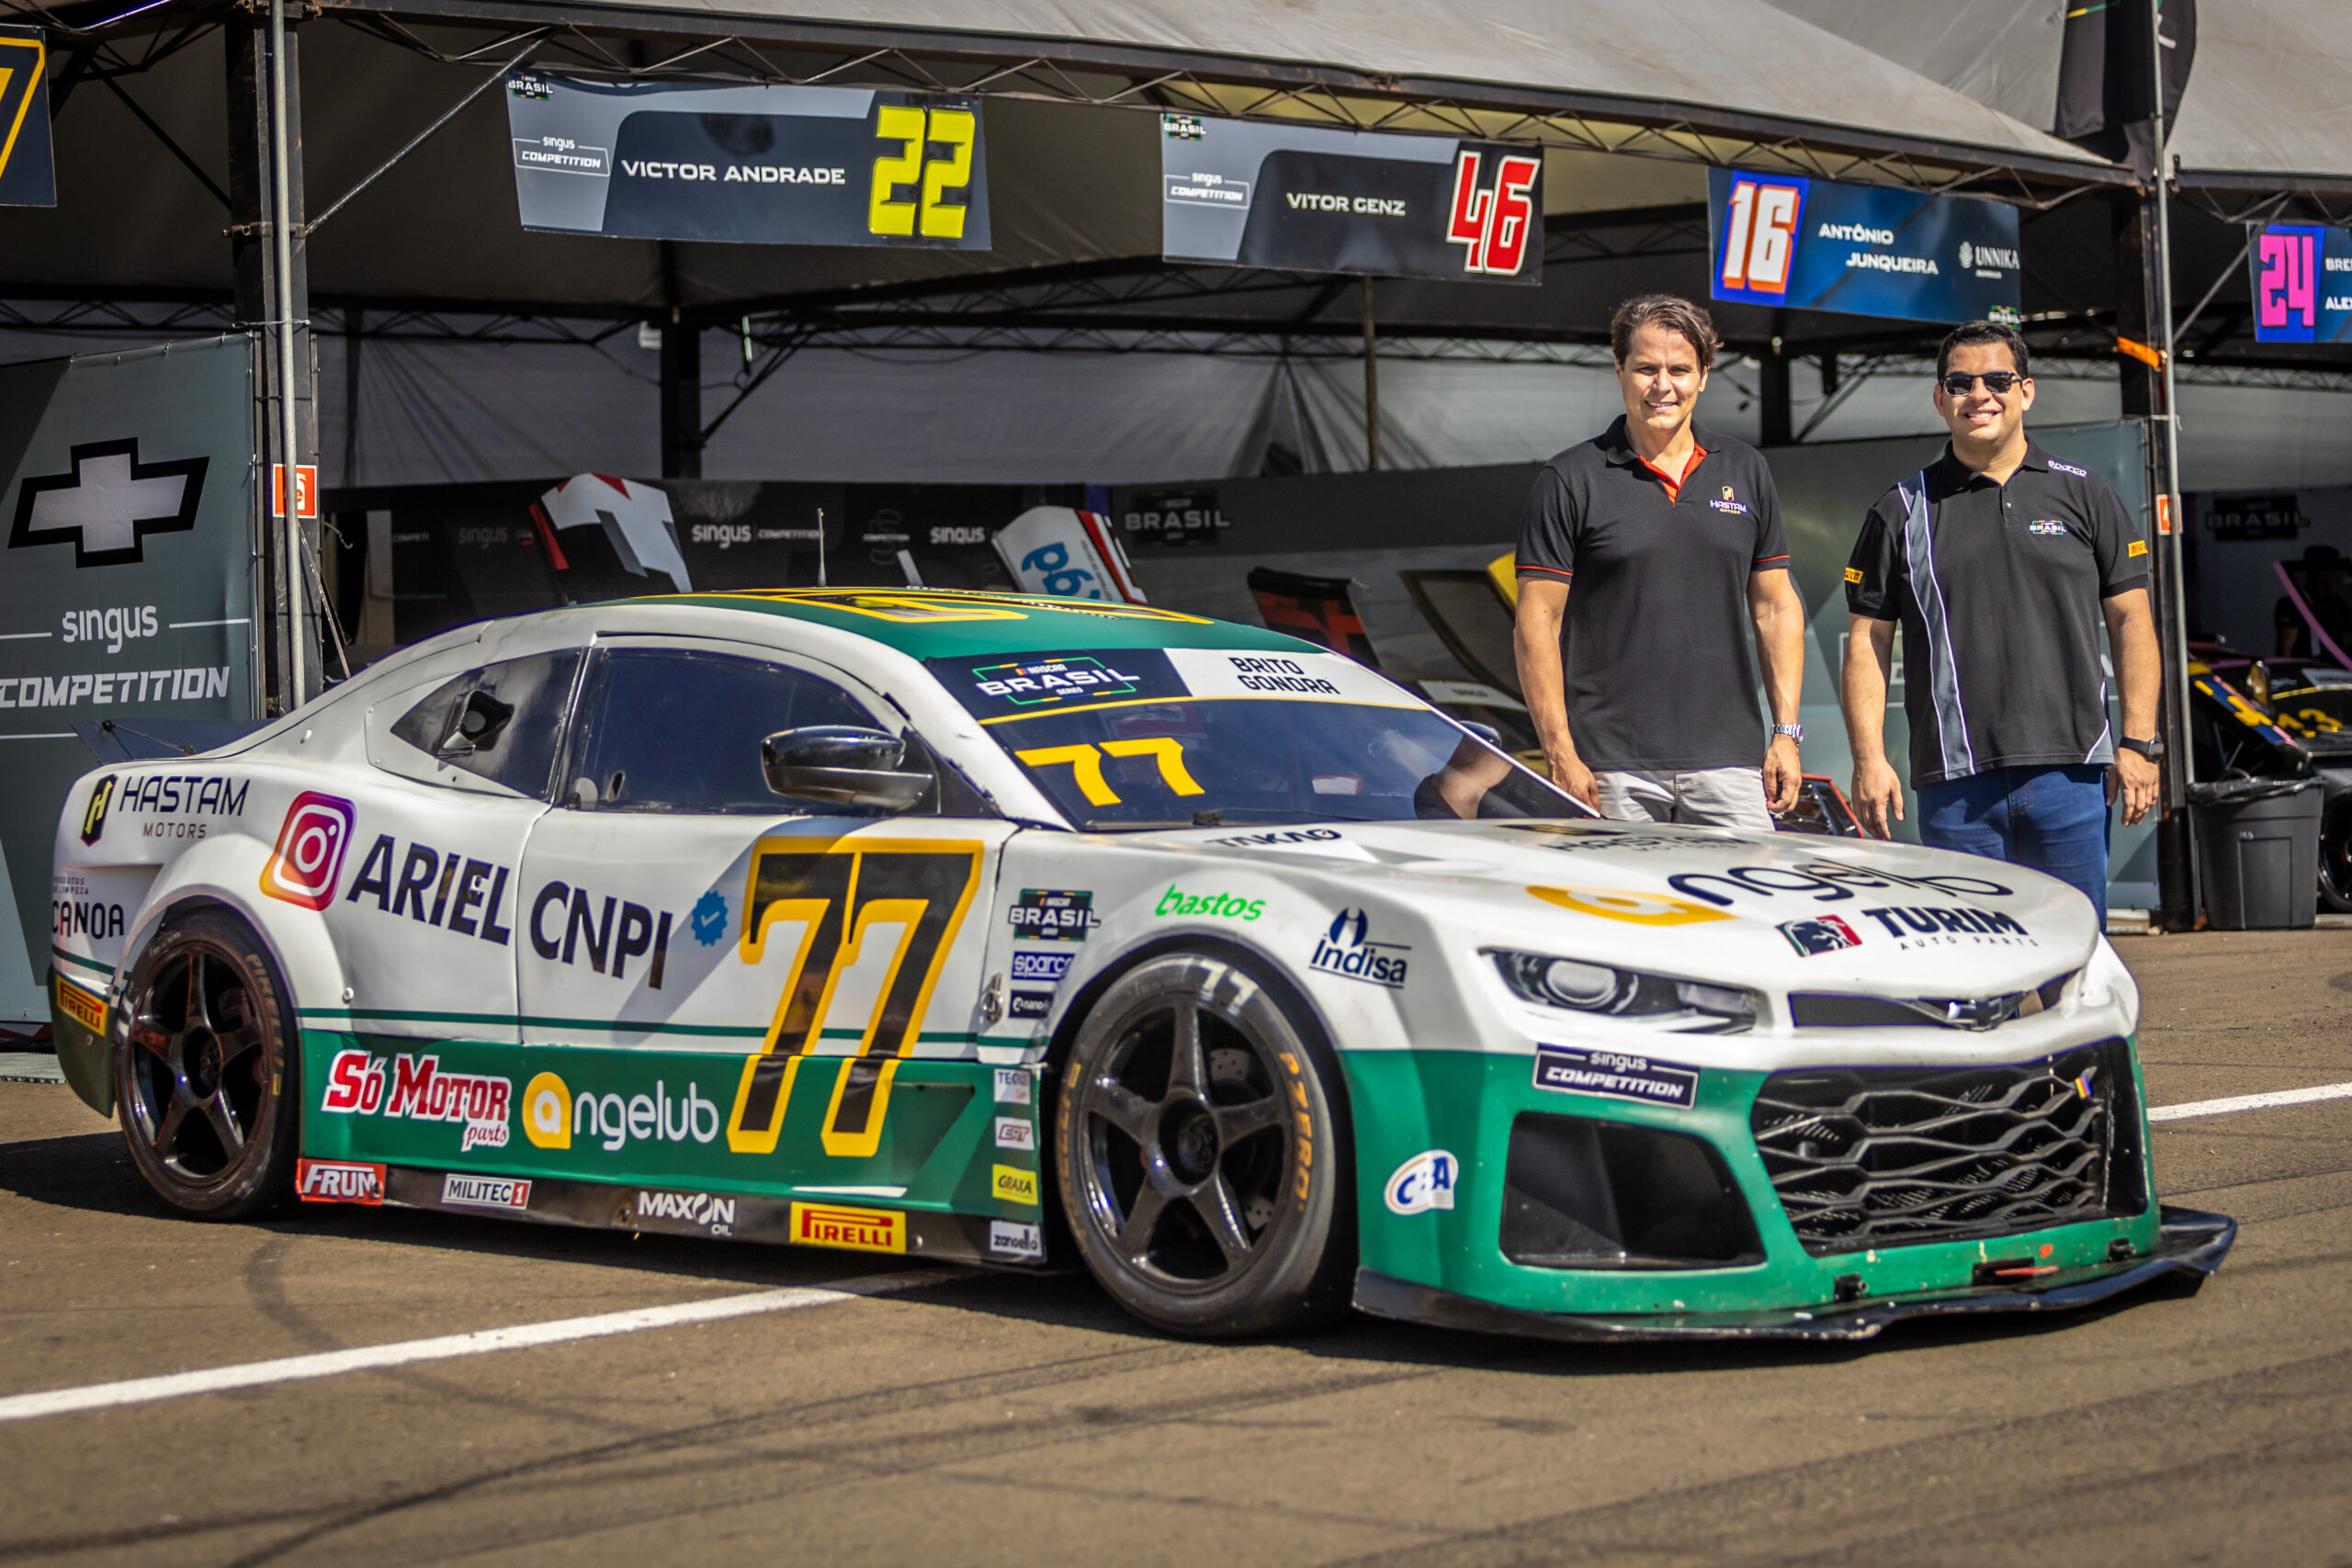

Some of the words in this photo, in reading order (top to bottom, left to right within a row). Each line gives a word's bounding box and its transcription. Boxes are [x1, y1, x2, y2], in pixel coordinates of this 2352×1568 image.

[508, 80, 553, 94] BRASIL
[1163, 122, 1207, 135] BRASIL
[542, 136, 575, 152] singus
[522, 151, 601, 168] COMPETITION
[620, 159, 717, 182] VICTOR
[724, 165, 845, 185] ANDRADE
[868, 105, 976, 238] 22
[1170, 186, 1243, 201] COMPETITION
[1286, 192, 1349, 212] VITOR
[1353, 197, 1406, 217] GENZ
[1446, 150, 1541, 276] 46
[1723, 181, 1798, 294] 16
[1818, 223, 1894, 245] ANTÔNIO
[1845, 252, 1939, 276] JUNQUEIRA
[1974, 245, 2020, 270] UNNIKA
[2259, 233, 2315, 327] 24
[2047, 460, 2086, 477] sparco
[1710, 500, 1747, 513] HASTAM
[1125, 510, 1231, 531] BRASIL
[2029, 524, 2066, 534] BRASIL
[458, 526, 507, 549] singus
[692, 522, 751, 549] singus
[62, 605, 158, 653] singus
[1027, 663, 1068, 675] NASCAR
[1228, 657, 1305, 675] BRITO
[0, 666, 230, 708] COMPETITION
[975, 668, 1141, 696] BRASIL
[1237, 674, 1341, 694] GONDRA
[1014, 737, 1205, 807] 77
[119, 775, 251, 817] HASTAM
[142, 822, 208, 839] MOTORS
[346, 833, 511, 946] ARIEL
[530, 880, 673, 990] CNPI
[1155, 884, 1267, 920] bastos
[51, 900, 125, 940] CANOA
[1009, 906, 1102, 929] BRASIL
[1861, 907, 2030, 938] TURIM
[59, 980, 104, 1030] PIRELLI
[726, 835, 985, 1157] 77
[1589, 1052, 1647, 1073] singus
[1545, 1066, 1684, 1099] COMPETITION
[522, 1071, 720, 1151] angelub
[465, 1123, 509, 1146] parts
[447, 1178, 512, 1202] MILITEC
[639, 1191, 735, 1225] MAXON
[711, 1224, 732, 1236] OIL
[801, 1208, 893, 1247] PIRELLI
